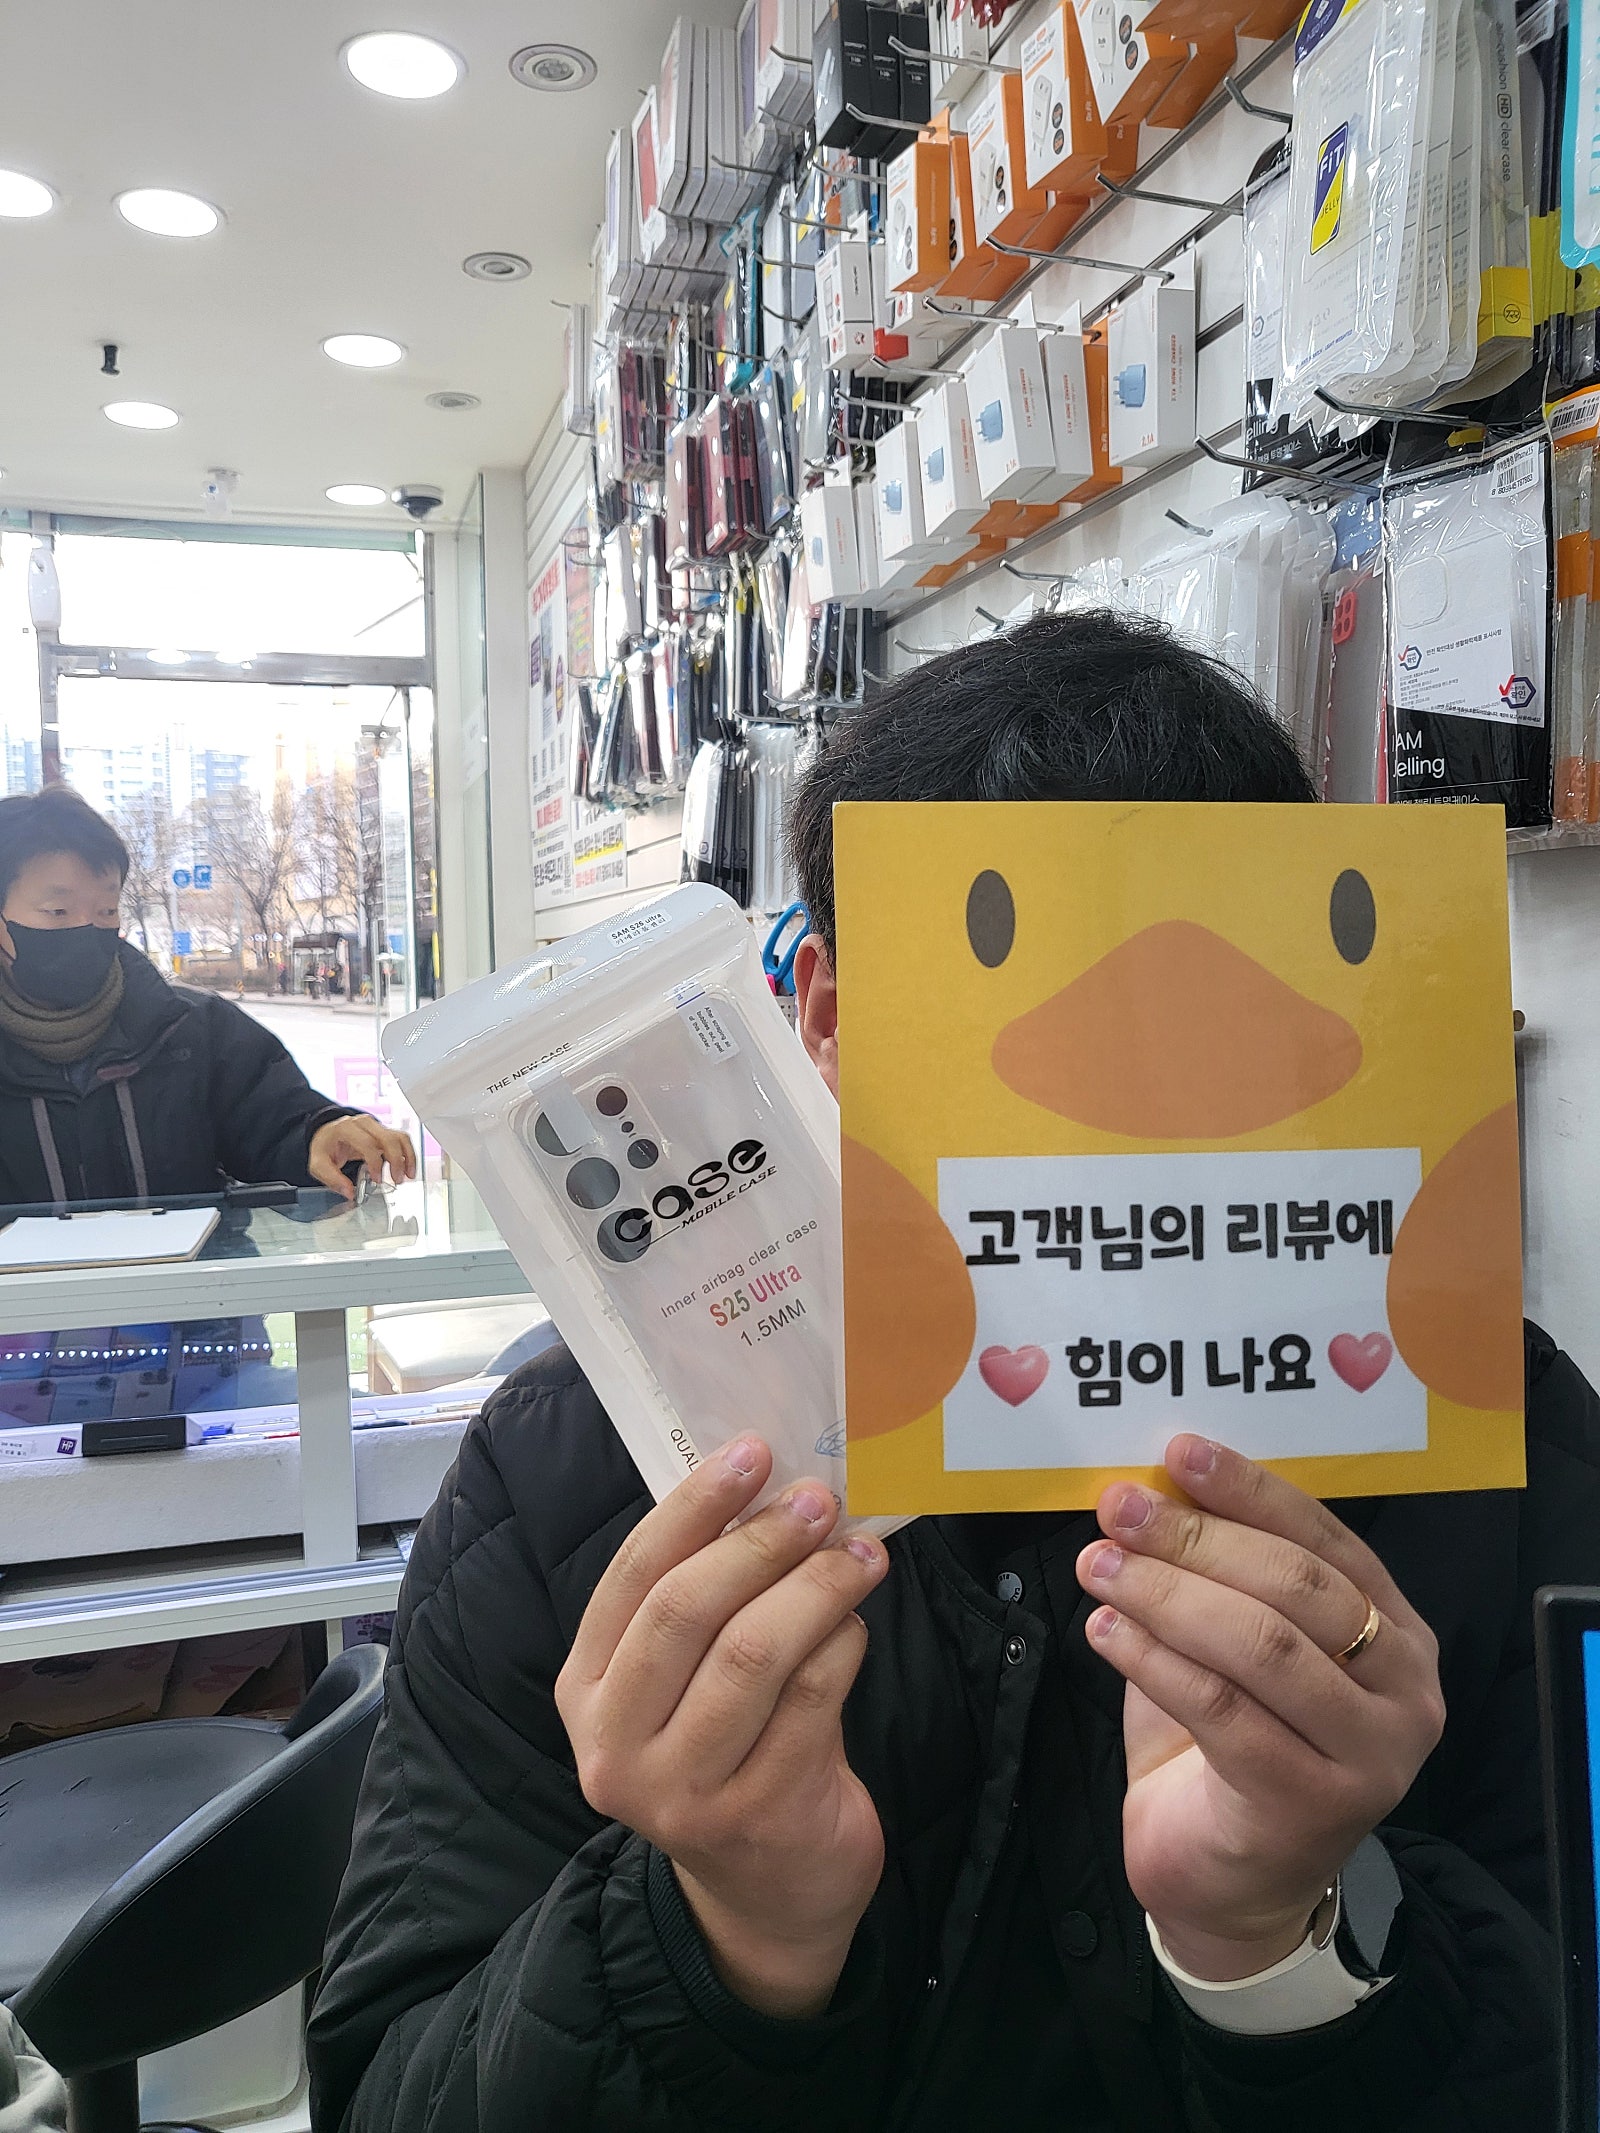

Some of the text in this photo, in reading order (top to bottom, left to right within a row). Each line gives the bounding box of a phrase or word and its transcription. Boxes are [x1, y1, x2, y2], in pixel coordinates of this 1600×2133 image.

[1501, 121, 1512, 151] clear
[1501, 153, 1512, 183] case
[1320, 195, 1341, 219] JELLY
[1246, 420, 1278, 441] elling
[1511, 690, 1526, 699] 확인
[1395, 730, 1423, 751] AM
[1392, 757, 1445, 778] Jelling
[611, 928, 630, 940] SAM
[644, 912, 663, 926] ultra
[696, 1010, 710, 1031] bubbles
[714, 1042, 725, 1053] peel
[712, 1020, 726, 1040] scraping
[486, 1042, 573, 1094] THE NEW CASE
[614, 1139, 768, 1243] case
[681, 1166, 778, 1228] MOBILE CASE
[965, 1199, 1393, 1271] 고객님의 리뷰에
[660, 1219, 818, 1318] Inner airbag clear case
[709, 1263, 802, 1327] S25 Ultra
[740, 1298, 808, 1347] 1.5MM
[1065, 1333, 1316, 1407] 힘이 나요
[670, 1428, 702, 1472] QUAL
